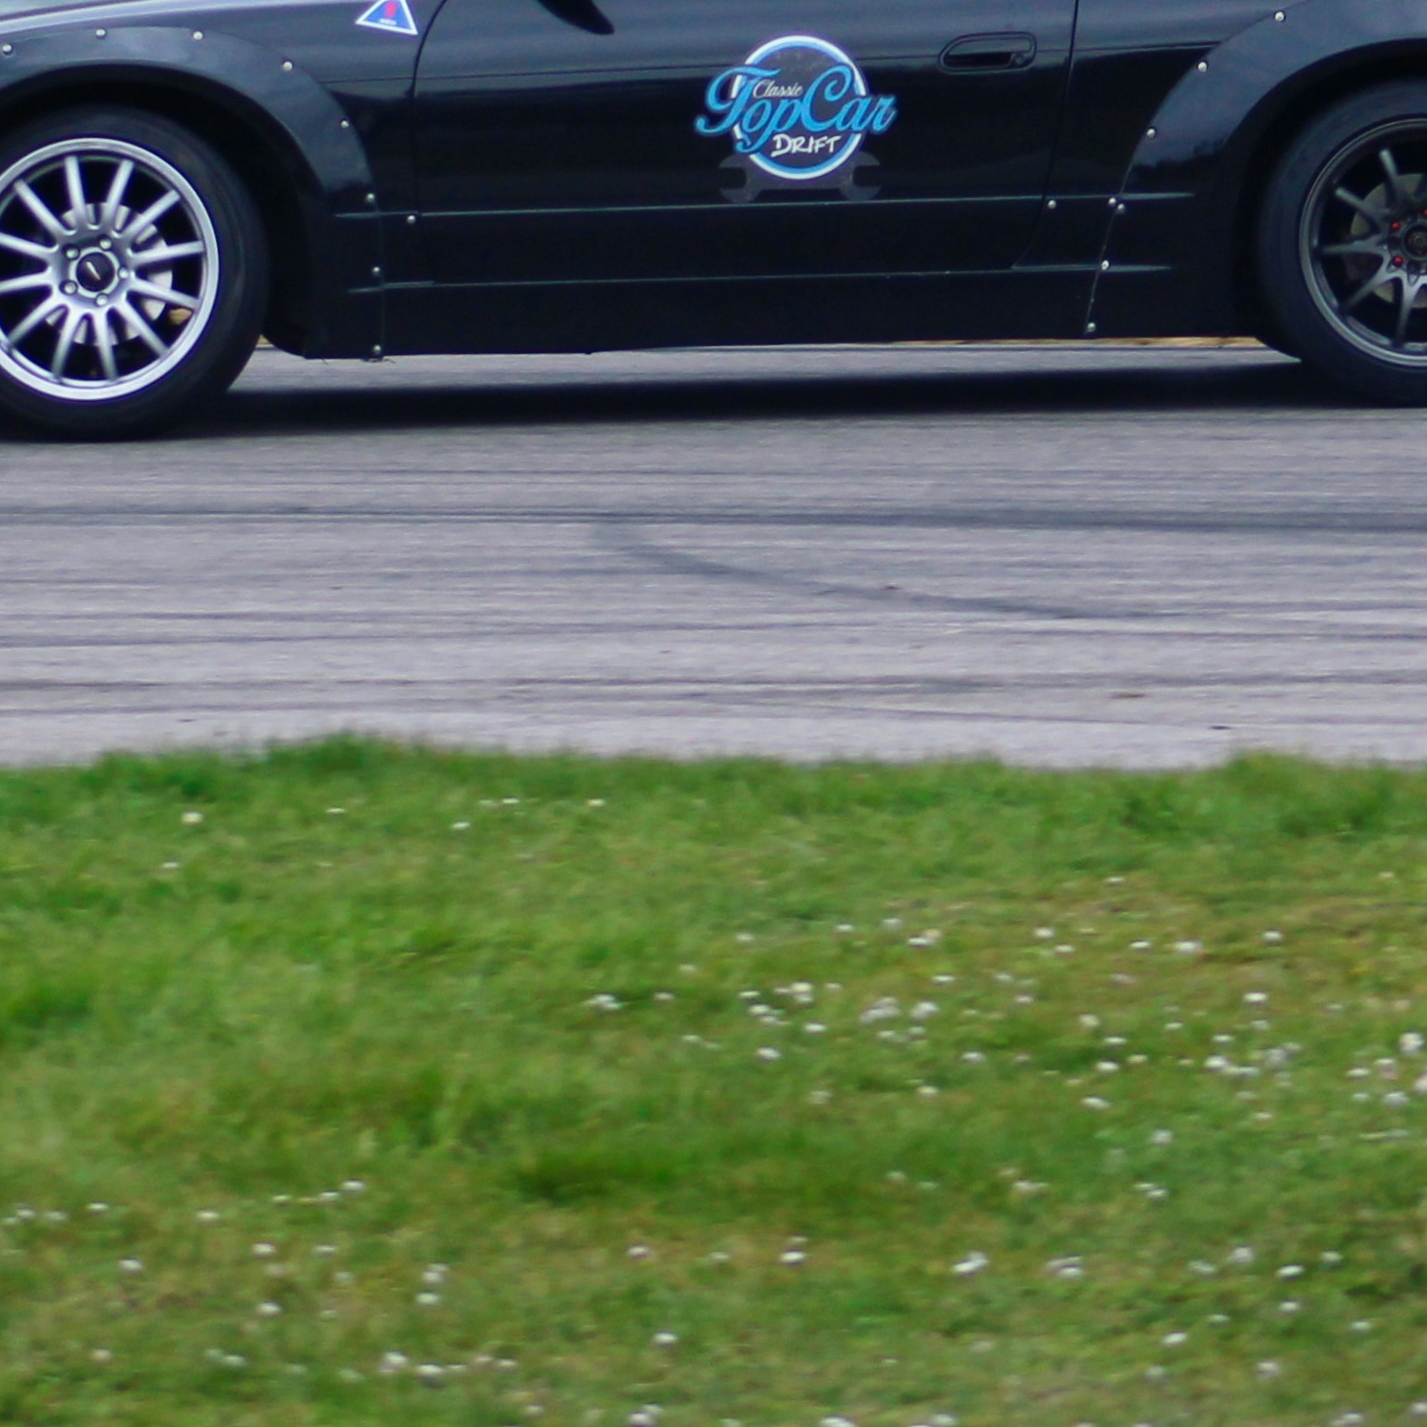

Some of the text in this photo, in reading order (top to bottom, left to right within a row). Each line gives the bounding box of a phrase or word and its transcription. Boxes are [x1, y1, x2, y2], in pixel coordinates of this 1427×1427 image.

[752, 80, 803, 98] Classic
[694, 65, 897, 153] TopCar
[771, 133, 841, 158] DRIFT
